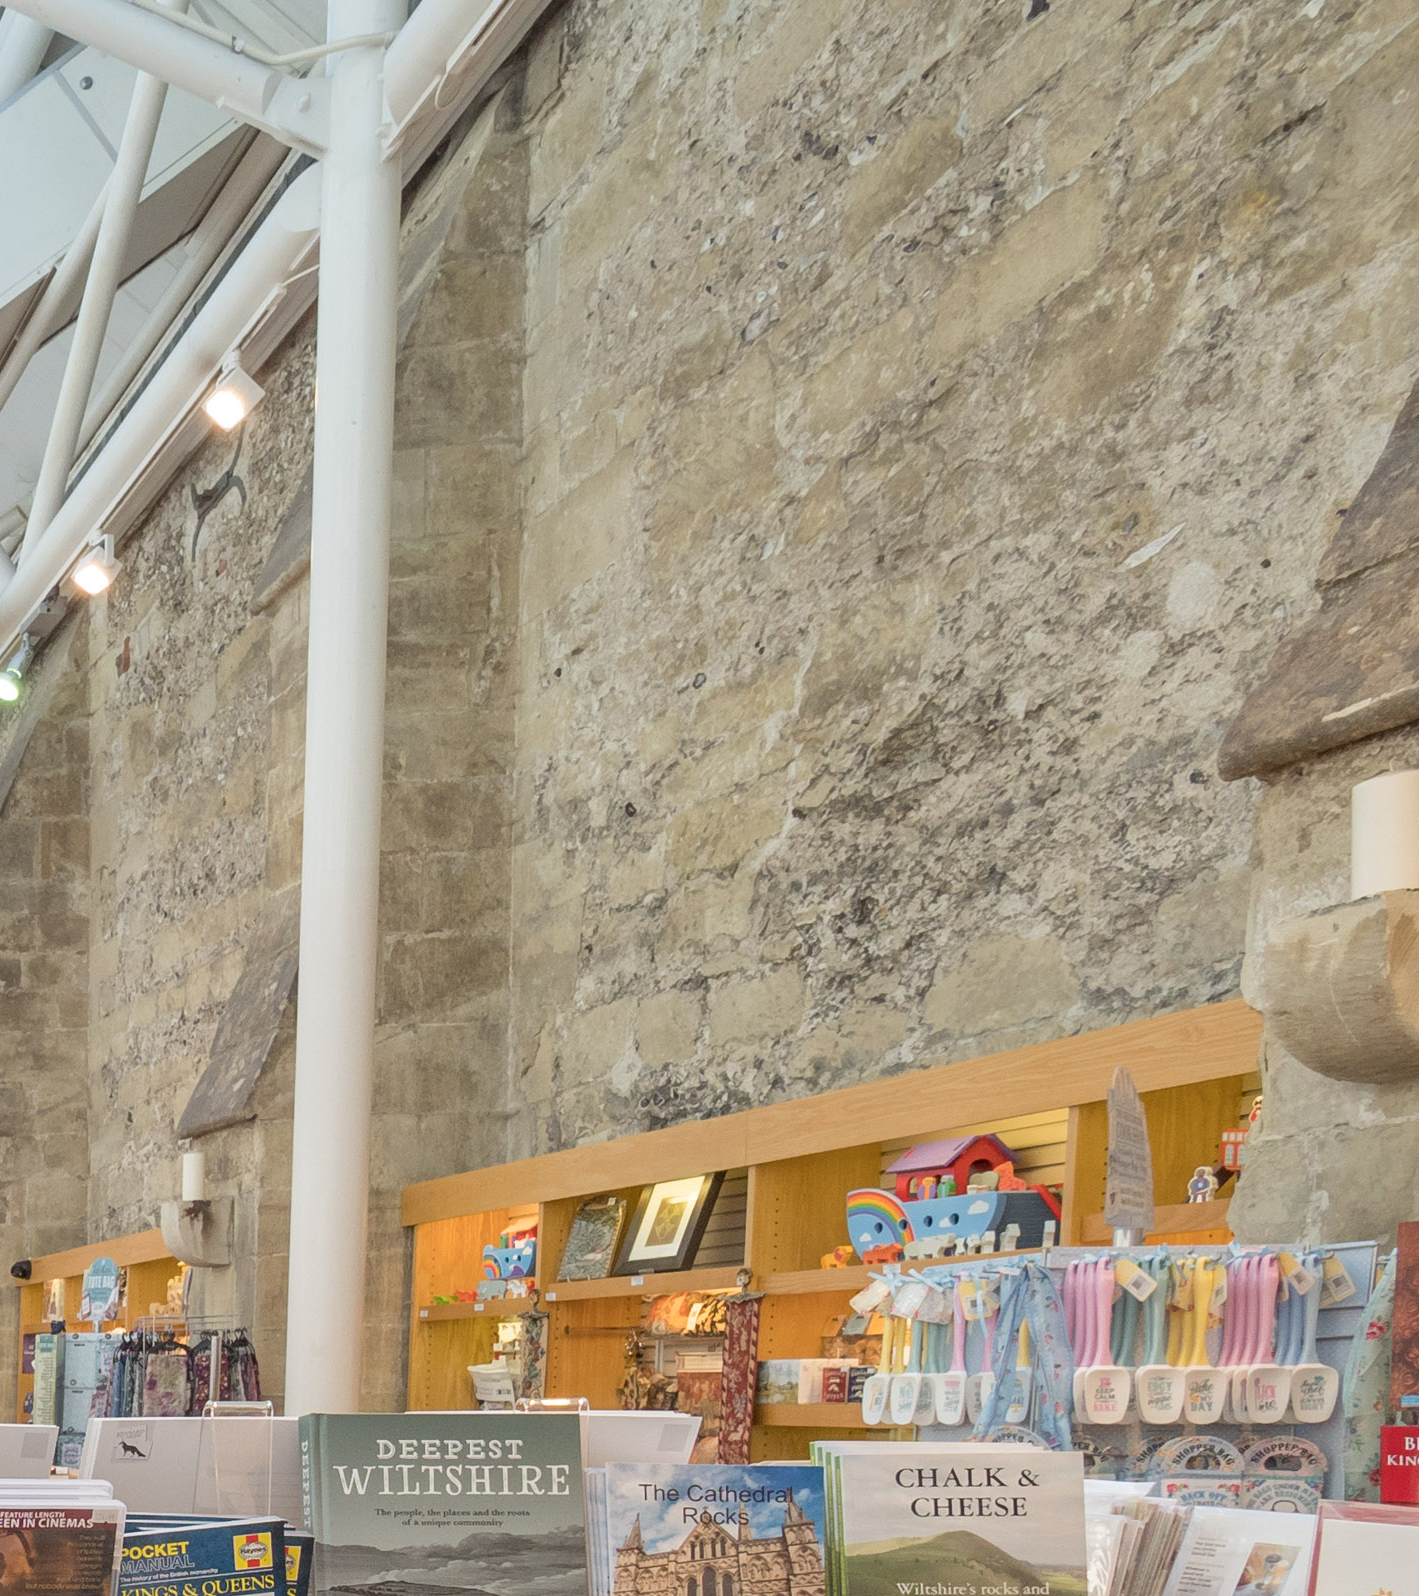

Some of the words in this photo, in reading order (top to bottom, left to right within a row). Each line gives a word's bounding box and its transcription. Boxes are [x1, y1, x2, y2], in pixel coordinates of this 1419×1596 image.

[1094, 1403, 1117, 1412] BAKE
[1190, 1401, 1213, 1412] DAY
[376, 1439, 523, 1459] DEEPEST
[1172, 1444, 1216, 1465] SHOPPER
[1216, 1447, 1235, 1465] BAG
[1251, 1444, 1299, 1463] SHOPPER
[1300, 1448, 1318, 1465] BAG
[332, 1464, 570, 1495] WILTSHIRE
[895, 1467, 1006, 1488] CHALK
[1018, 1468, 1040, 1487] &
[638, 1484, 679, 1502] The
[687, 1484, 793, 1503] Cathedral
[682, 1506, 749, 1526] Rocks
[910, 1496, 1028, 1518] CHEESE
[23, 1518, 36, 1528] IN
[38, 1518, 94, 1529] CINEMAS
[896, 1581, 976, 1596] Wiltshire's
[980, 1582, 1018, 1596] rocks
[1023, 1582, 1050, 1595] and
